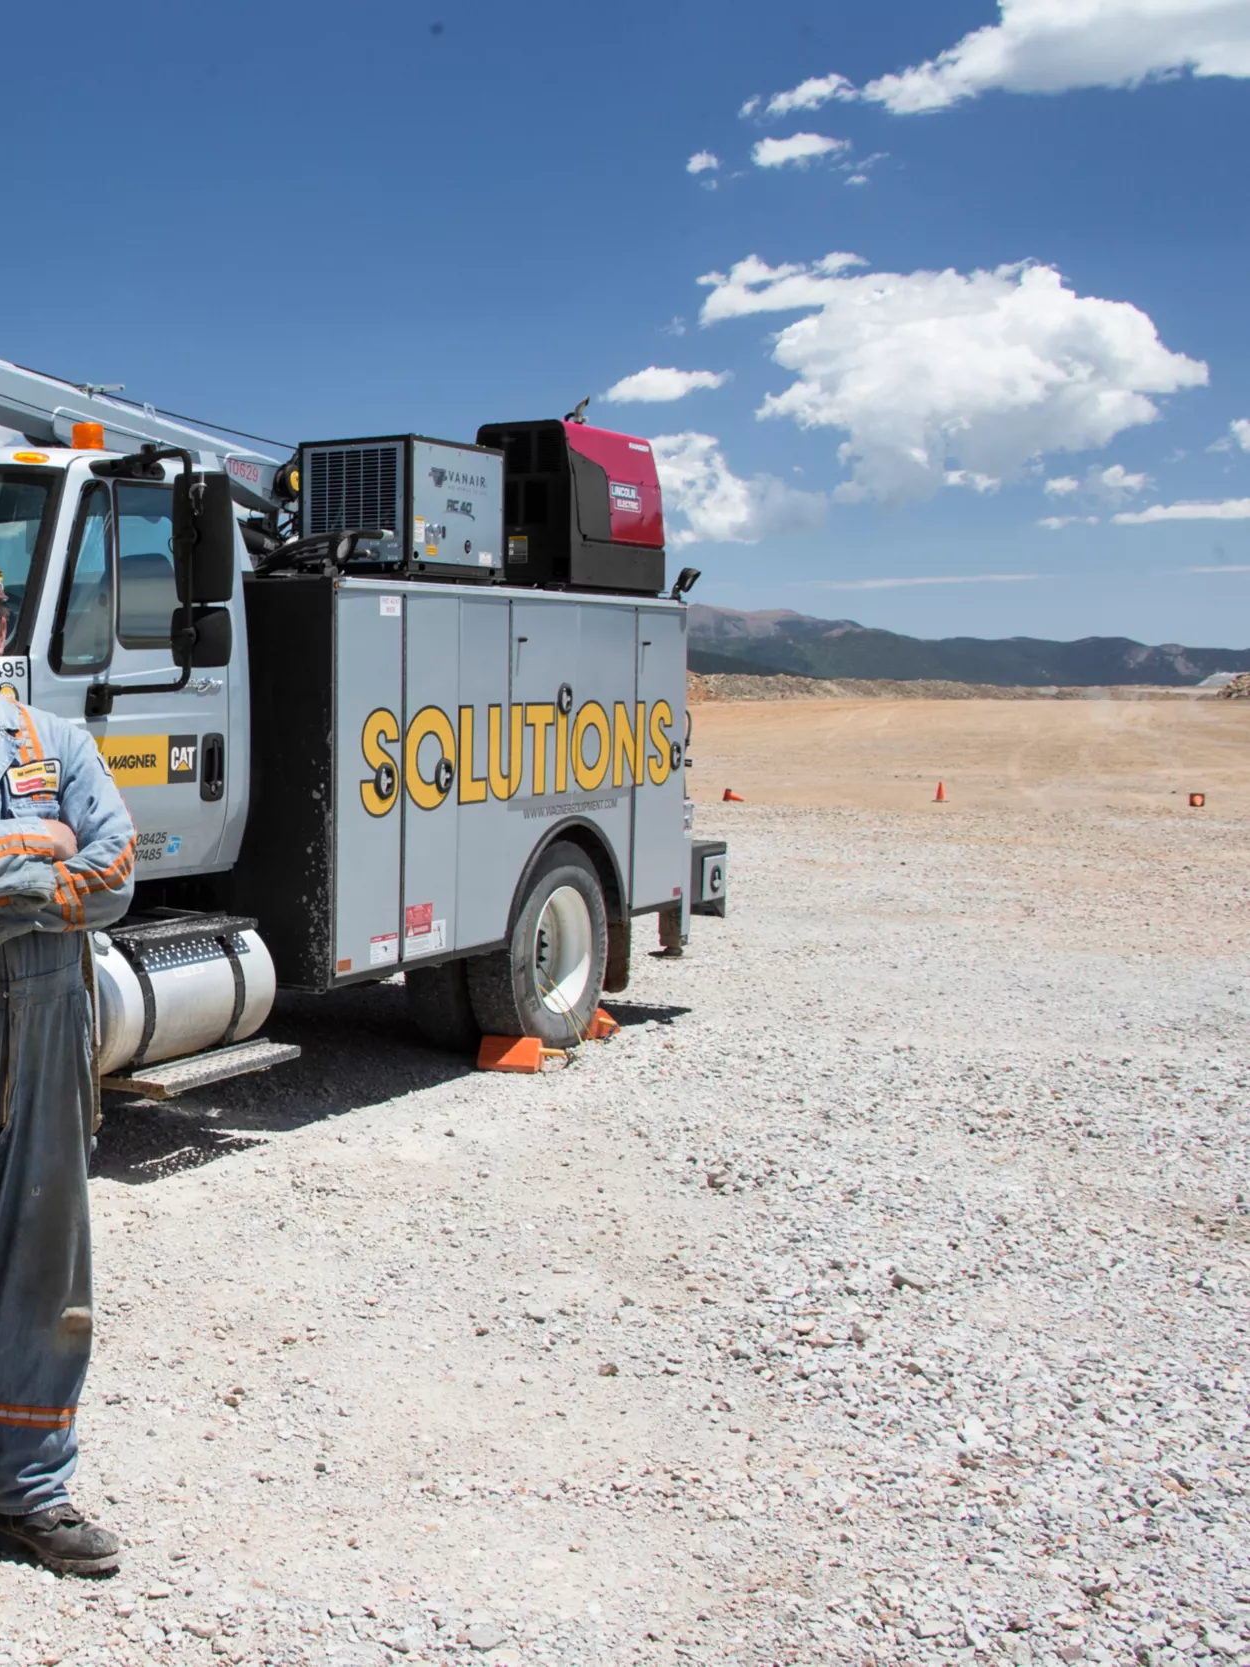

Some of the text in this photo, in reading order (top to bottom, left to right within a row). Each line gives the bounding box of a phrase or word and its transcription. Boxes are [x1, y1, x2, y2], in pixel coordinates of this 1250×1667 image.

[228, 458, 259, 483] 10629
[448, 470, 486, 489] VANAIR
[611, 485, 636, 499] LINCOLN
[616, 499, 639, 511] ELECTRIC
[107, 753, 158, 770] WAGNER
[170, 746, 196, 771] CAT
[360, 698, 673, 818] SOLUTIONS
